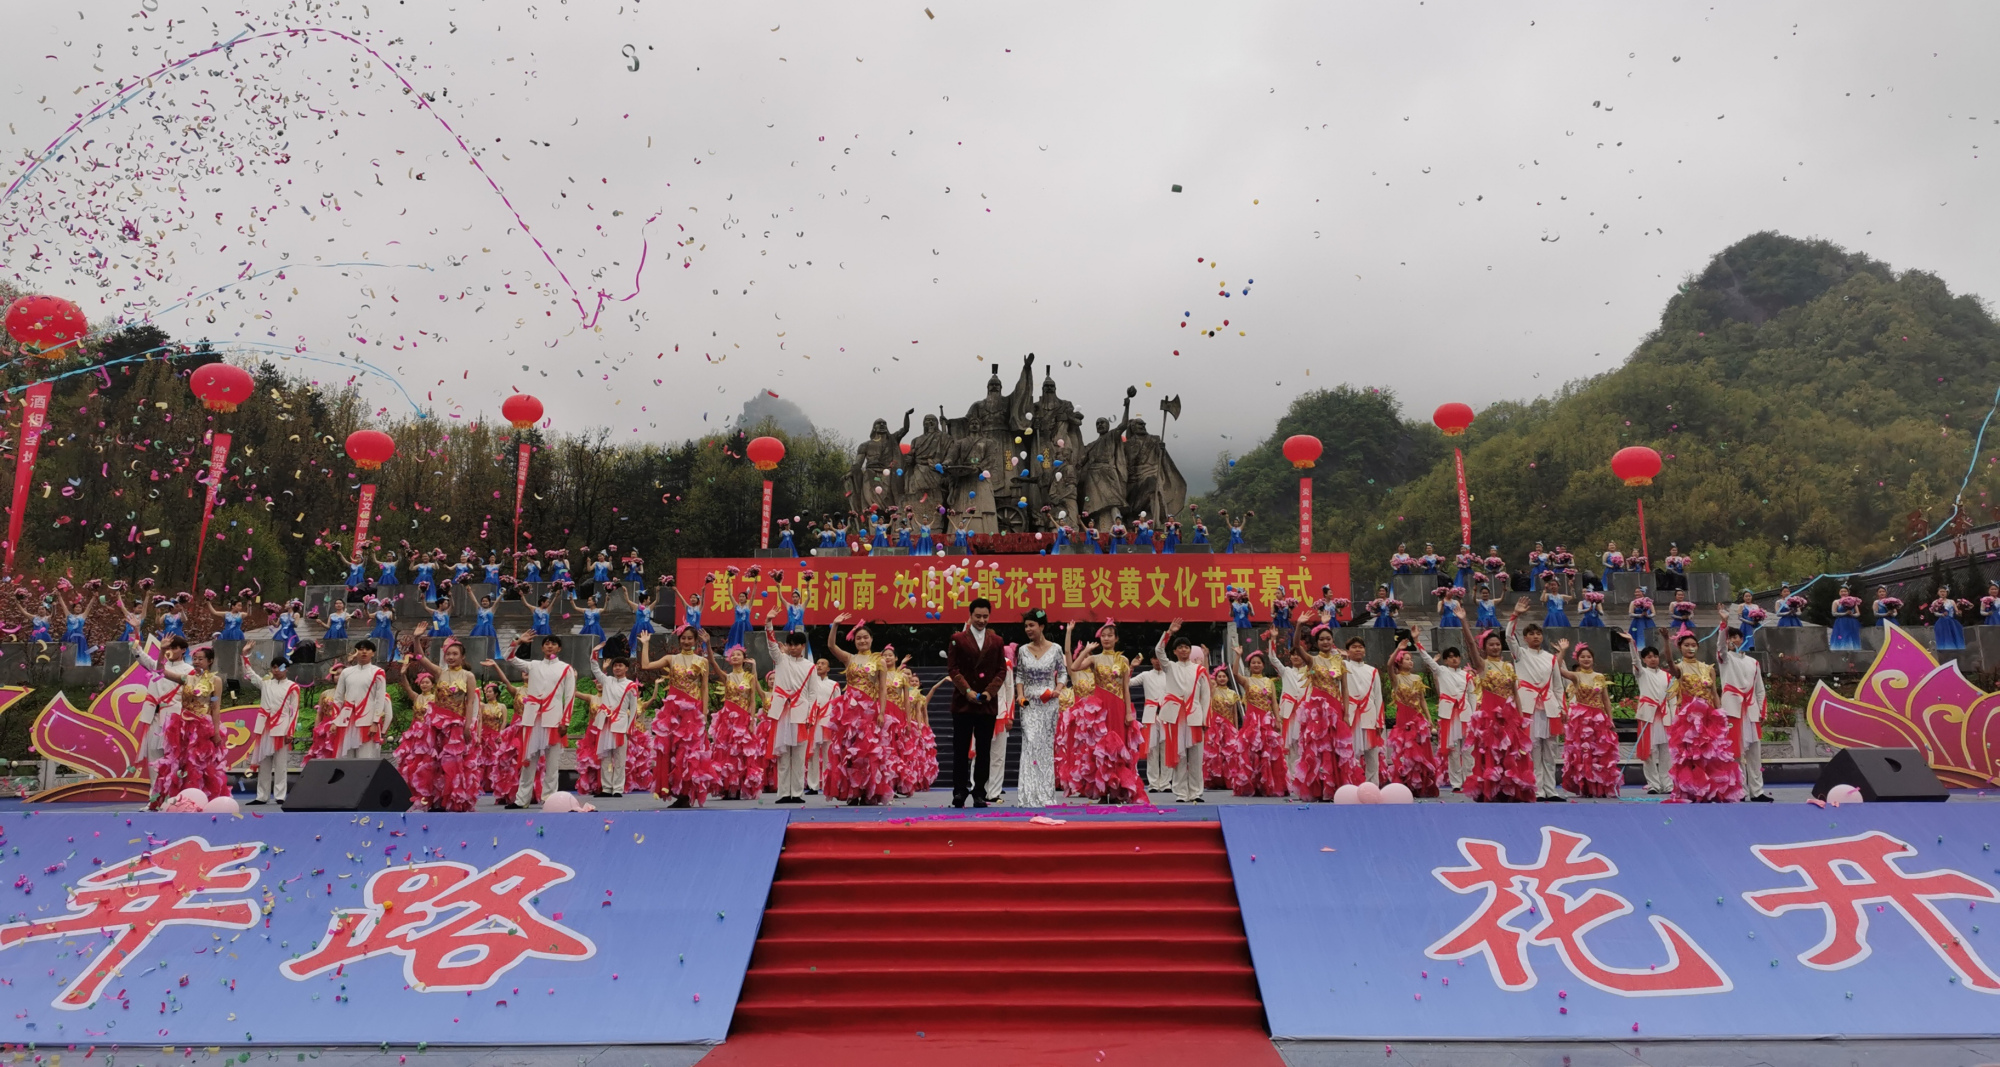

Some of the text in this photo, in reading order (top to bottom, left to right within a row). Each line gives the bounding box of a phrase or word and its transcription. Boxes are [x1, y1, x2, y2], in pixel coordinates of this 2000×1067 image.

[1301, 487, 1310, 546] 炎黄会盟地
[1981, 533, 2000, 551] Ta
[1424, 825, 2000, 997] 花开
